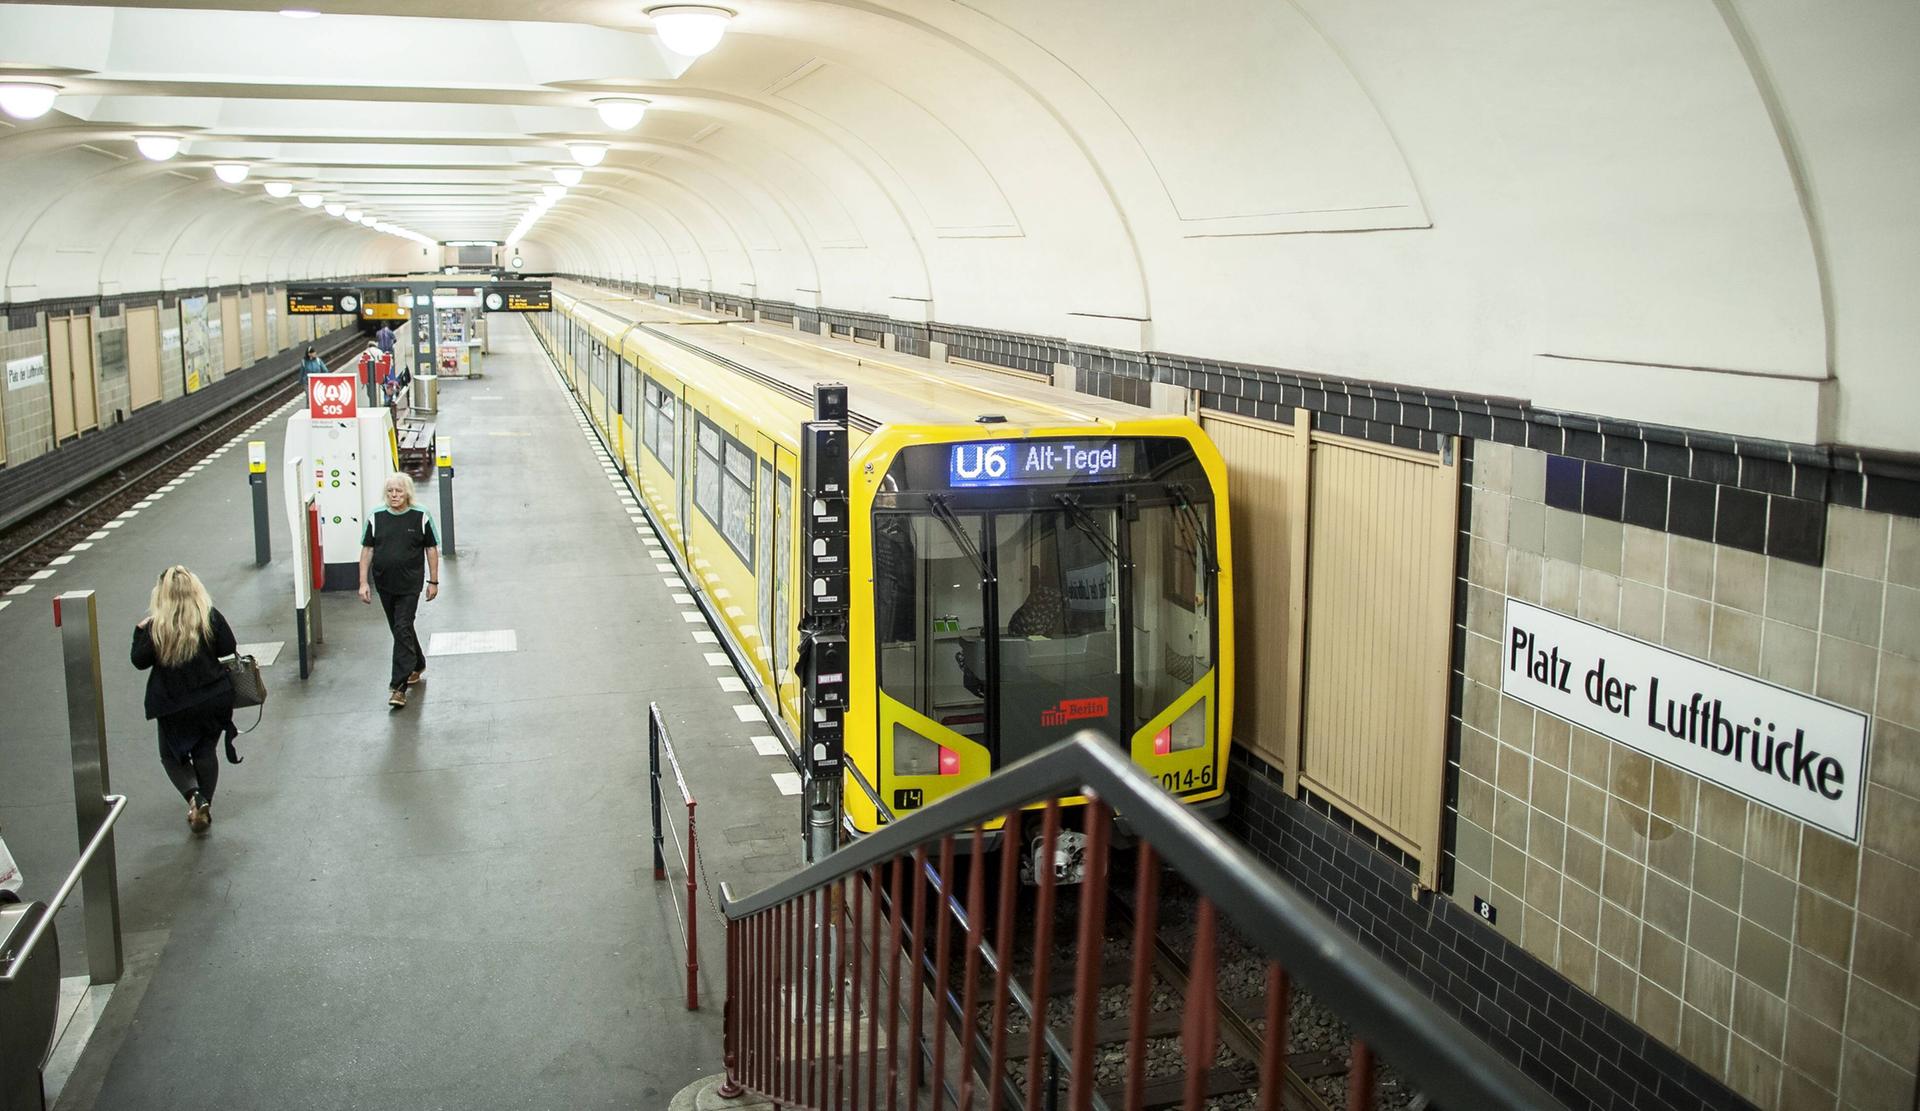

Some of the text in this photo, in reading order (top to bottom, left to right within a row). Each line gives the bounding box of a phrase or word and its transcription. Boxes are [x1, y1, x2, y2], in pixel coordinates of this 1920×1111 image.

[322, 404, 343, 415] SOS
[956, 443, 1117, 479] U6 Alt-Tegel
[1069, 702, 1105, 716] Berlin
[1510, 626, 1845, 801] Platz der Luftbrücke
[1153, 765, 1211, 792] 014-6
[903, 790, 921, 807] 14
[1480, 902, 1490, 919] 8
